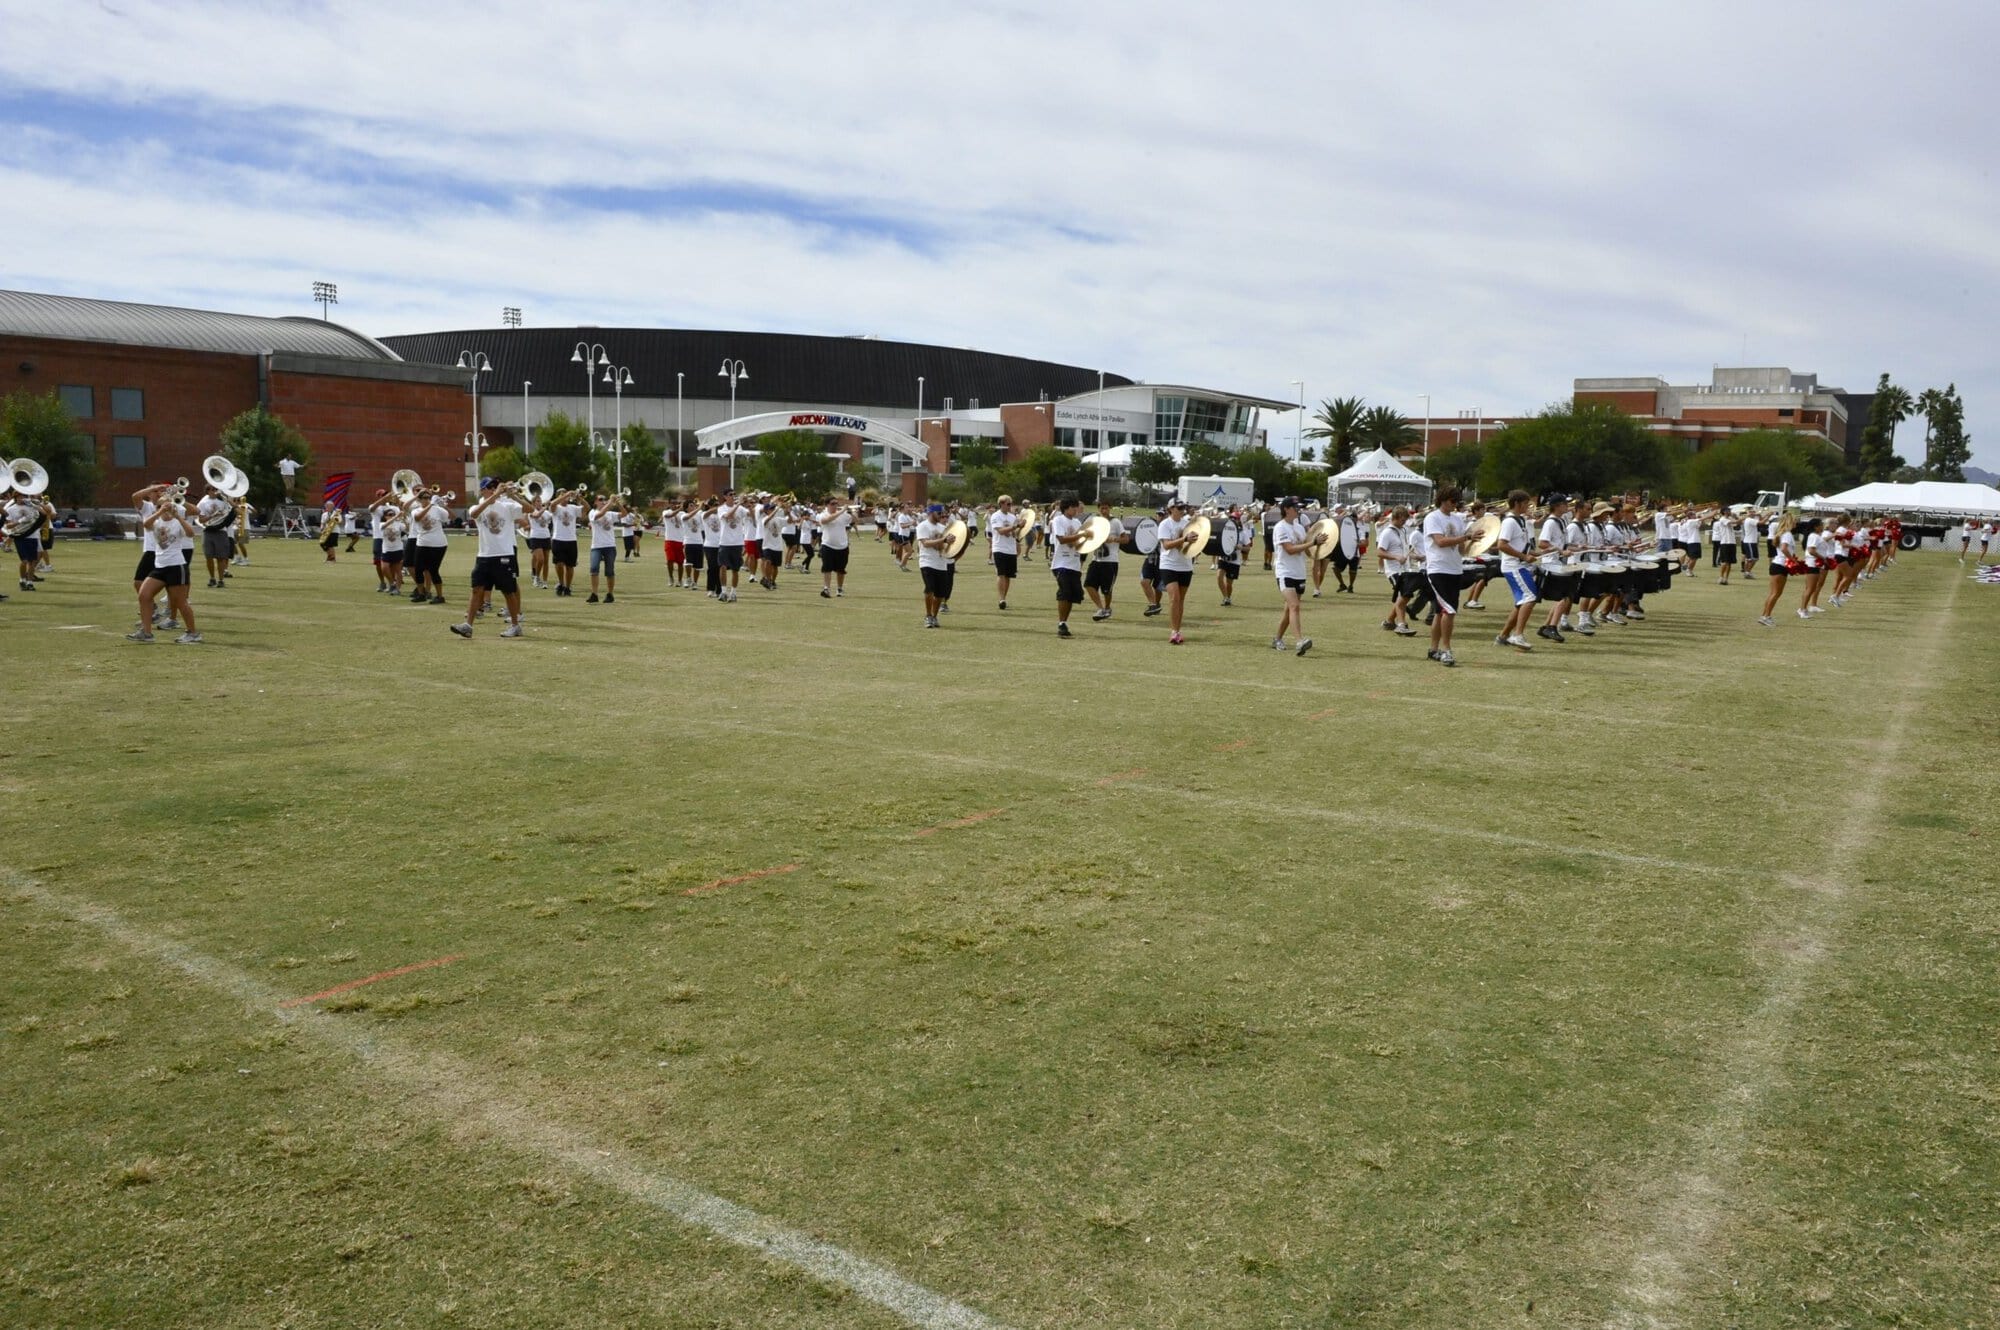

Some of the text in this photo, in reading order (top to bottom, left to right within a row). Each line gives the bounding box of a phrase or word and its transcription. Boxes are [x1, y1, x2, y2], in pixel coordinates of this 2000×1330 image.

[1057, 410, 1072, 419] Eddie
[1073, 412, 1088, 421] Lynch
[1089, 413, 1108, 422] Athleics
